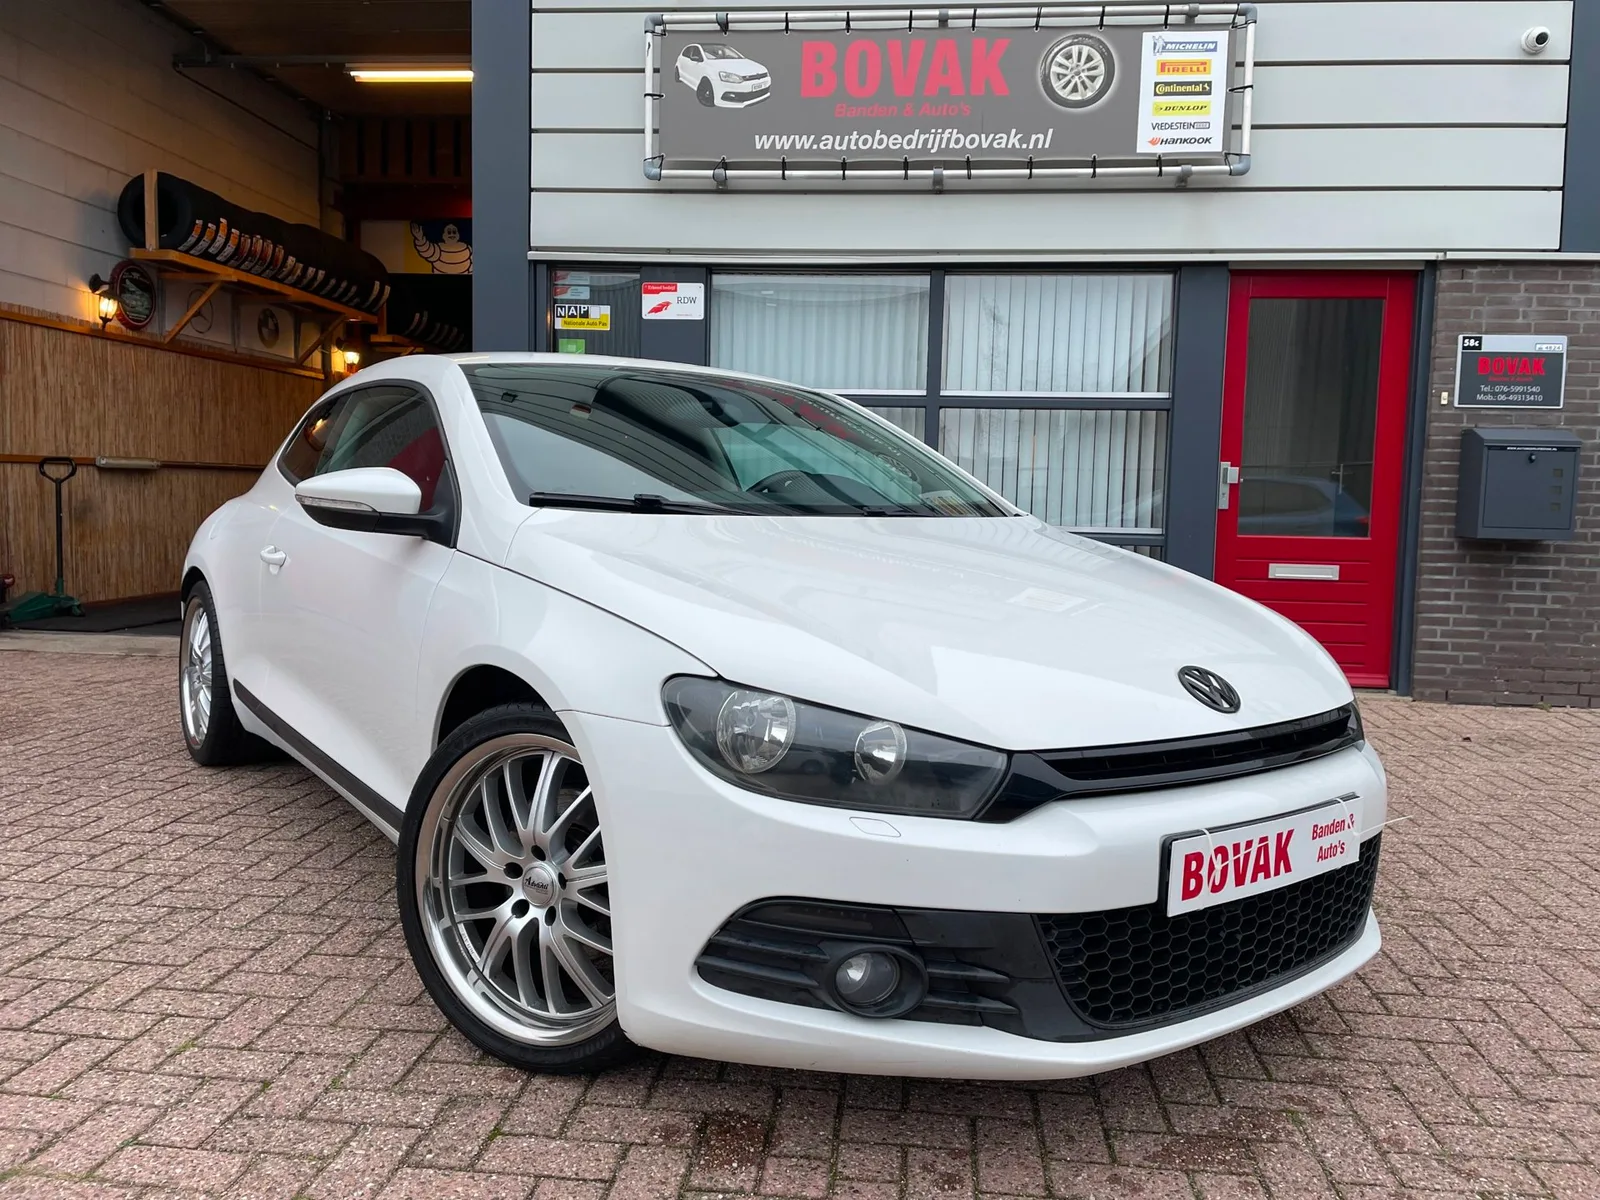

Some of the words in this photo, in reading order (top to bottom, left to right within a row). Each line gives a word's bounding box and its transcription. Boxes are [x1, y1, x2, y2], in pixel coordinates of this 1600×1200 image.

[1165, 42, 1216, 50] MICHELIN
[801, 38, 1012, 98] BOVAK
[1160, 61, 1207, 73] PIRELLI
[1155, 83, 1203, 95] Continental
[834, 104, 897, 118] Banden
[903, 103, 914, 117] &
[919, 101, 971, 117] Auto's
[1151, 121, 1195, 131] VREDESTEIN
[754, 128, 1054, 153] www.autobedrijfbovak.nl
[676, 296, 697, 305] RDW
[557, 305, 588, 317] NAP
[1463, 338, 1480, 347] 58c
[1477, 356, 1546, 375] BOVAK
[1494, 385, 1541, 393] 076-5991540
[1311, 818, 1345, 841] Banden
[1316, 839, 1346, 863] Auto's
[1181, 828, 1295, 901] BOVAK
